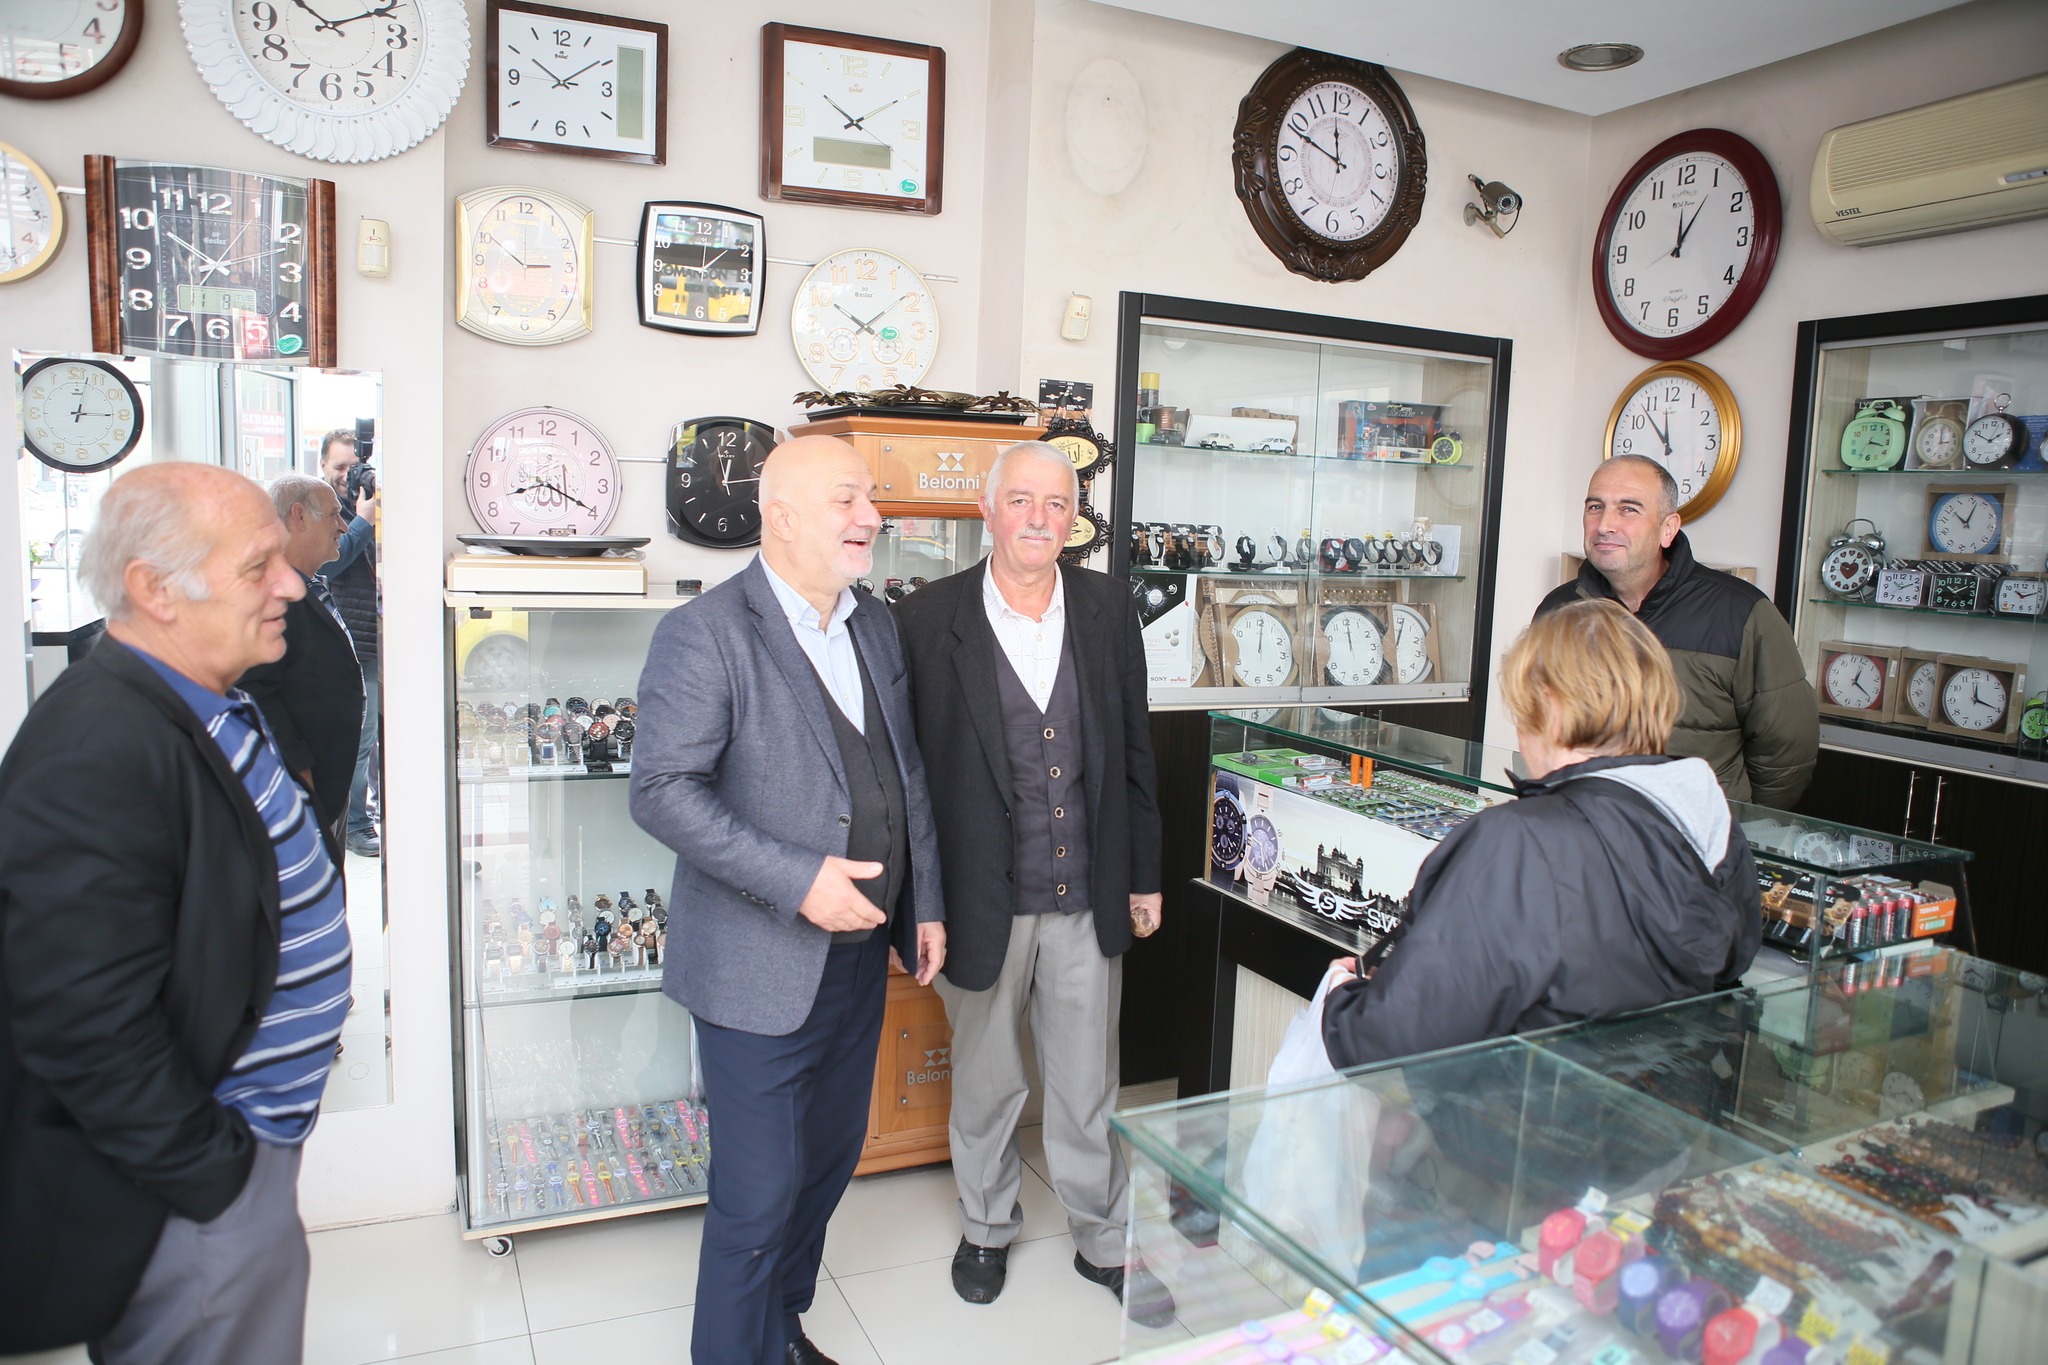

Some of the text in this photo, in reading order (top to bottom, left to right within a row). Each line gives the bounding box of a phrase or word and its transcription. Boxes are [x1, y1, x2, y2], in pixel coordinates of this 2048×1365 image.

[252, 2, 277, 31] 9
[386, 24, 408, 49] 3
[553, 29, 571, 47] 12
[262, 34, 288, 62] 8
[372, 50, 398, 77] 4
[840, 55, 868, 78] 12
[290, 63, 310, 88] 7
[353, 71, 374, 97] 5
[508, 68, 520, 85] 9
[320, 73, 342, 101] 6
[601, 81, 612, 97] 3
[1308, 94, 1326, 119] 11
[1332, 91, 1351, 116] 12
[785, 105, 805, 126] 9
[1358, 108, 1370, 126] 1
[555, 120, 566, 136] 6
[902, 120, 920, 140] 3
[1287, 112, 1309, 139] 10
[1370, 131, 1388, 149] 2
[1279, 144, 1298, 162] 9
[843, 169, 862, 189] 6
[1375, 163, 1392, 180] 3
[1677, 165, 1696, 186] 12
[1713, 168, 1718, 187] 1
[1284, 177, 1303, 195] 8
[1652, 180, 1664, 201] 11
[160, 188, 183, 211] 11
[198, 191, 232, 215] 12
[251, 198, 261, 218] 1
[519, 202, 533, 214] 12
[1301, 196, 1319, 216] 7
[1370, 189, 1384, 210] 4
[1730, 192, 1743, 213] 2
[120, 207, 155, 230] 10
[496, 210, 505, 221] 11
[551, 216, 554, 226] 1
[1326, 210, 1339, 233] 6
[1350, 207, 1364, 230] 5
[1628, 210, 1645, 230] 10
[1836, 208, 1862, 217] VESTEL
[279, 223, 301, 244] 2
[674, 220, 686, 231] 11
[696, 222, 712, 235] 12
[724, 226, 729, 237] 1
[479, 232, 492, 244] 10
[561, 238, 569, 249] 2
[655, 236, 670, 248] 10
[1737, 226, 1748, 247] 3
[126, 248, 151, 270] 9
[475, 254, 484, 265] 9
[741, 245, 749, 257] 2
[1617, 246, 1627, 264] 9
[280, 262, 302, 283] 3
[564, 263, 573, 273] 3
[654, 259, 663, 272] 9
[740, 268, 748, 281] 3
[855, 258, 878, 280] 12
[479, 278, 488, 288] 8
[830, 265, 847, 286] 11
[890, 270, 897, 290] 1
[1723, 265, 1734, 285] 4
[561, 285, 569, 295] 4
[654, 284, 663, 296] 8
[1624, 278, 1634, 296] 8
[128, 289, 152, 311] 8
[738, 293, 746, 304] 4
[809, 286, 832, 307] 10
[905, 292, 920, 312] 2
[1698, 295, 1709, 315] 5
[280, 302, 302, 322] 4
[493, 306, 501, 315] 7
[547, 310, 556, 320] 5
[672, 303, 680, 315] 7
[695, 306, 704, 318] 6
[718, 308, 726, 319] 5
[1641, 301, 1650, 320] 7
[1668, 308, 1678, 327] 6
[165, 315, 188, 336] 7
[206, 318, 230, 339] 6
[246, 319, 268, 341] 5
[520, 321, 529, 331] 6
[911, 321, 925, 340] 3
[809, 343, 825, 363] 8
[903, 349, 917, 369] 4
[830, 364, 845, 385] 7
[856, 374, 871, 393] 6
[883, 367, 897, 387] 5
[1647, 396, 1657, 411] 11
[1665, 387, 1680, 402] 12
[1691, 393, 1695, 408] 1
[1631, 415, 1645, 429] 10
[1700, 410, 1710, 426] 2
[509, 426, 524, 443] 11
[538, 420, 557, 436] 12
[571, 431, 578, 445] 1
[718, 432, 736, 447] 12
[1623, 438, 1632, 453] 9
[1705, 435, 1716, 450] 3
[589, 450, 600, 466] 2
[1696, 461, 1707, 476] 4
[480, 472, 491, 488] 9
[598, 479, 608, 494] 3
[681, 473, 691, 487] 9
[920, 473, 979, 489] Belonni
[1681, 479, 1691, 494] 5
[488, 501, 499, 517] 8
[588, 506, 598, 520] 4
[510, 522, 521, 534] 7
[718, 517, 727, 532] 6
[1920, 906, 1939, 914] TOSHIBA
